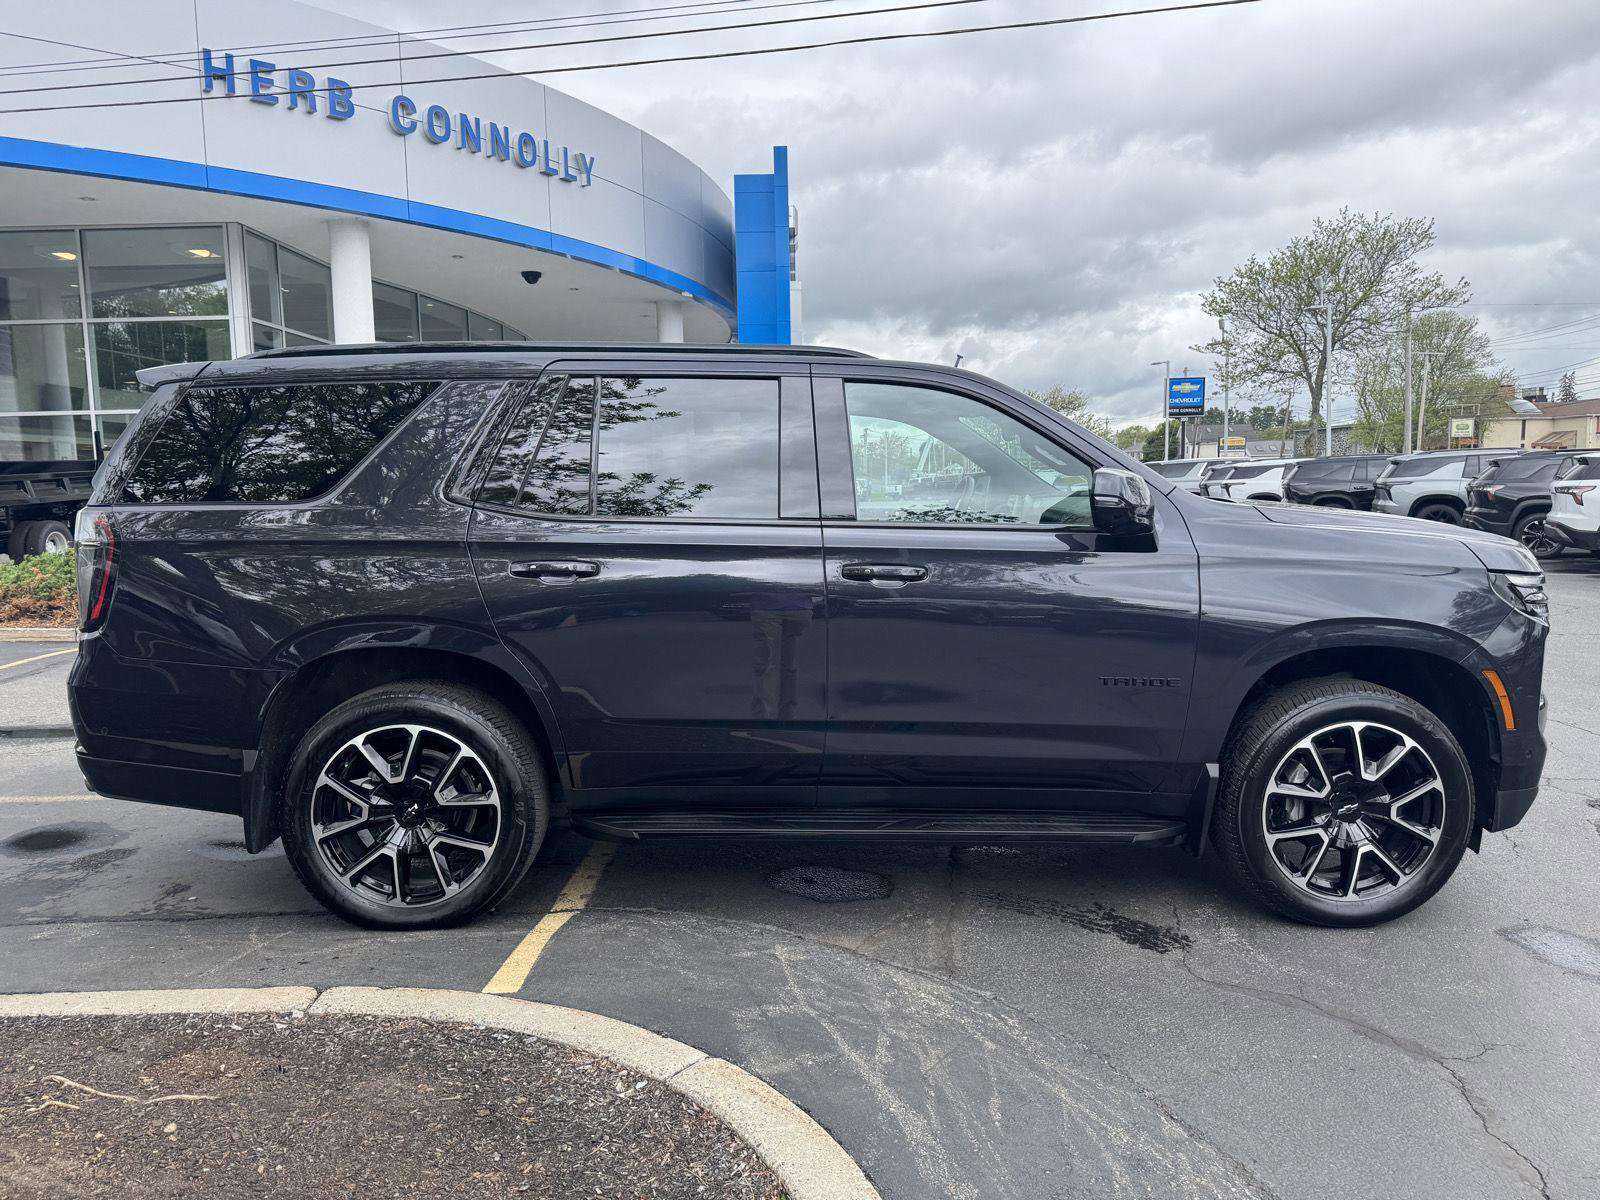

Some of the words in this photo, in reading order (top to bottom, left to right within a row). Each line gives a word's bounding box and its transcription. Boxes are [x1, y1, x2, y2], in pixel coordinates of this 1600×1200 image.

[201, 48, 355, 121] HERB
[388, 94, 595, 187] CONNOLLY
[1099, 676, 1181, 687] TAHOE
